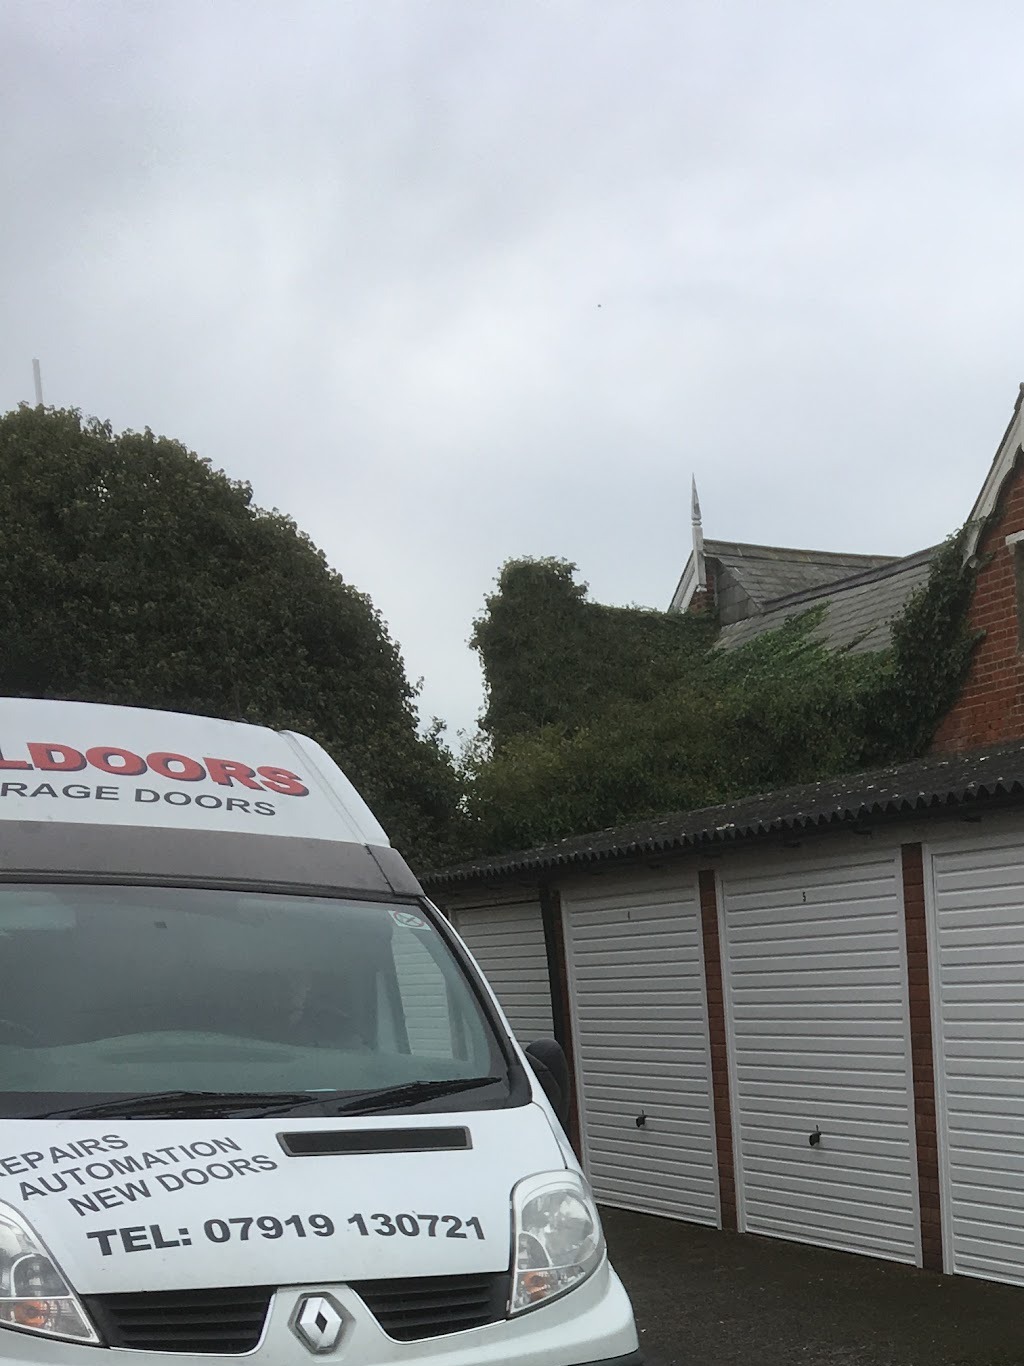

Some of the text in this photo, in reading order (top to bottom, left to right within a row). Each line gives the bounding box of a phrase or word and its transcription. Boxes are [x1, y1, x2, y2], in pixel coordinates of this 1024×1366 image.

[134, 788, 276, 816] DOORS
[0, 1134, 128, 1176] EPAIRS
[19, 1137, 242, 1200] AUTOMATION
[68, 1154, 278, 1216] NEW DOORS
[86, 1212, 486, 1256] TEL: 07919 130721
